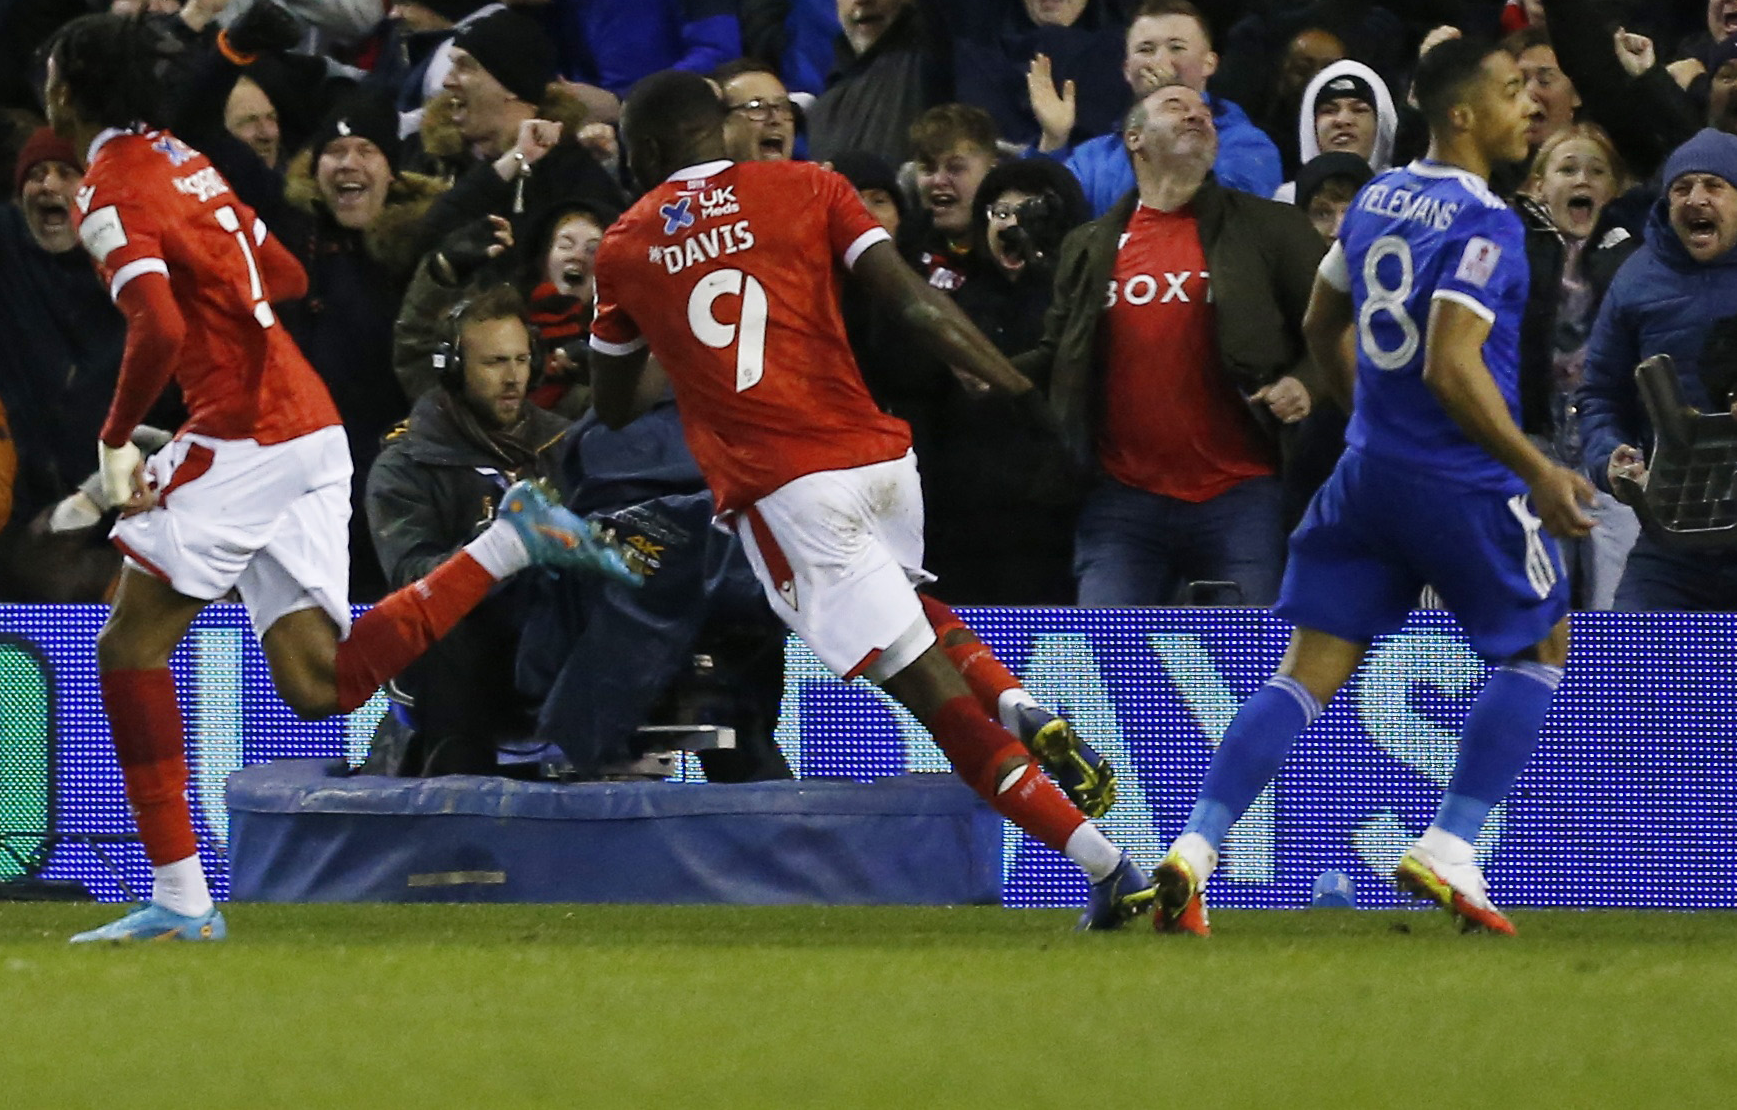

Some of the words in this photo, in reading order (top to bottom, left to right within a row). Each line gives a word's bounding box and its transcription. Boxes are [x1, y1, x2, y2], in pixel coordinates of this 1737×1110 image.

[699, 185, 737, 207] UK
[701, 202, 740, 220] Meds
[663, 220, 755, 275] DAVIS
[687, 268, 769, 393] 9
[1359, 235, 1420, 371] 8
